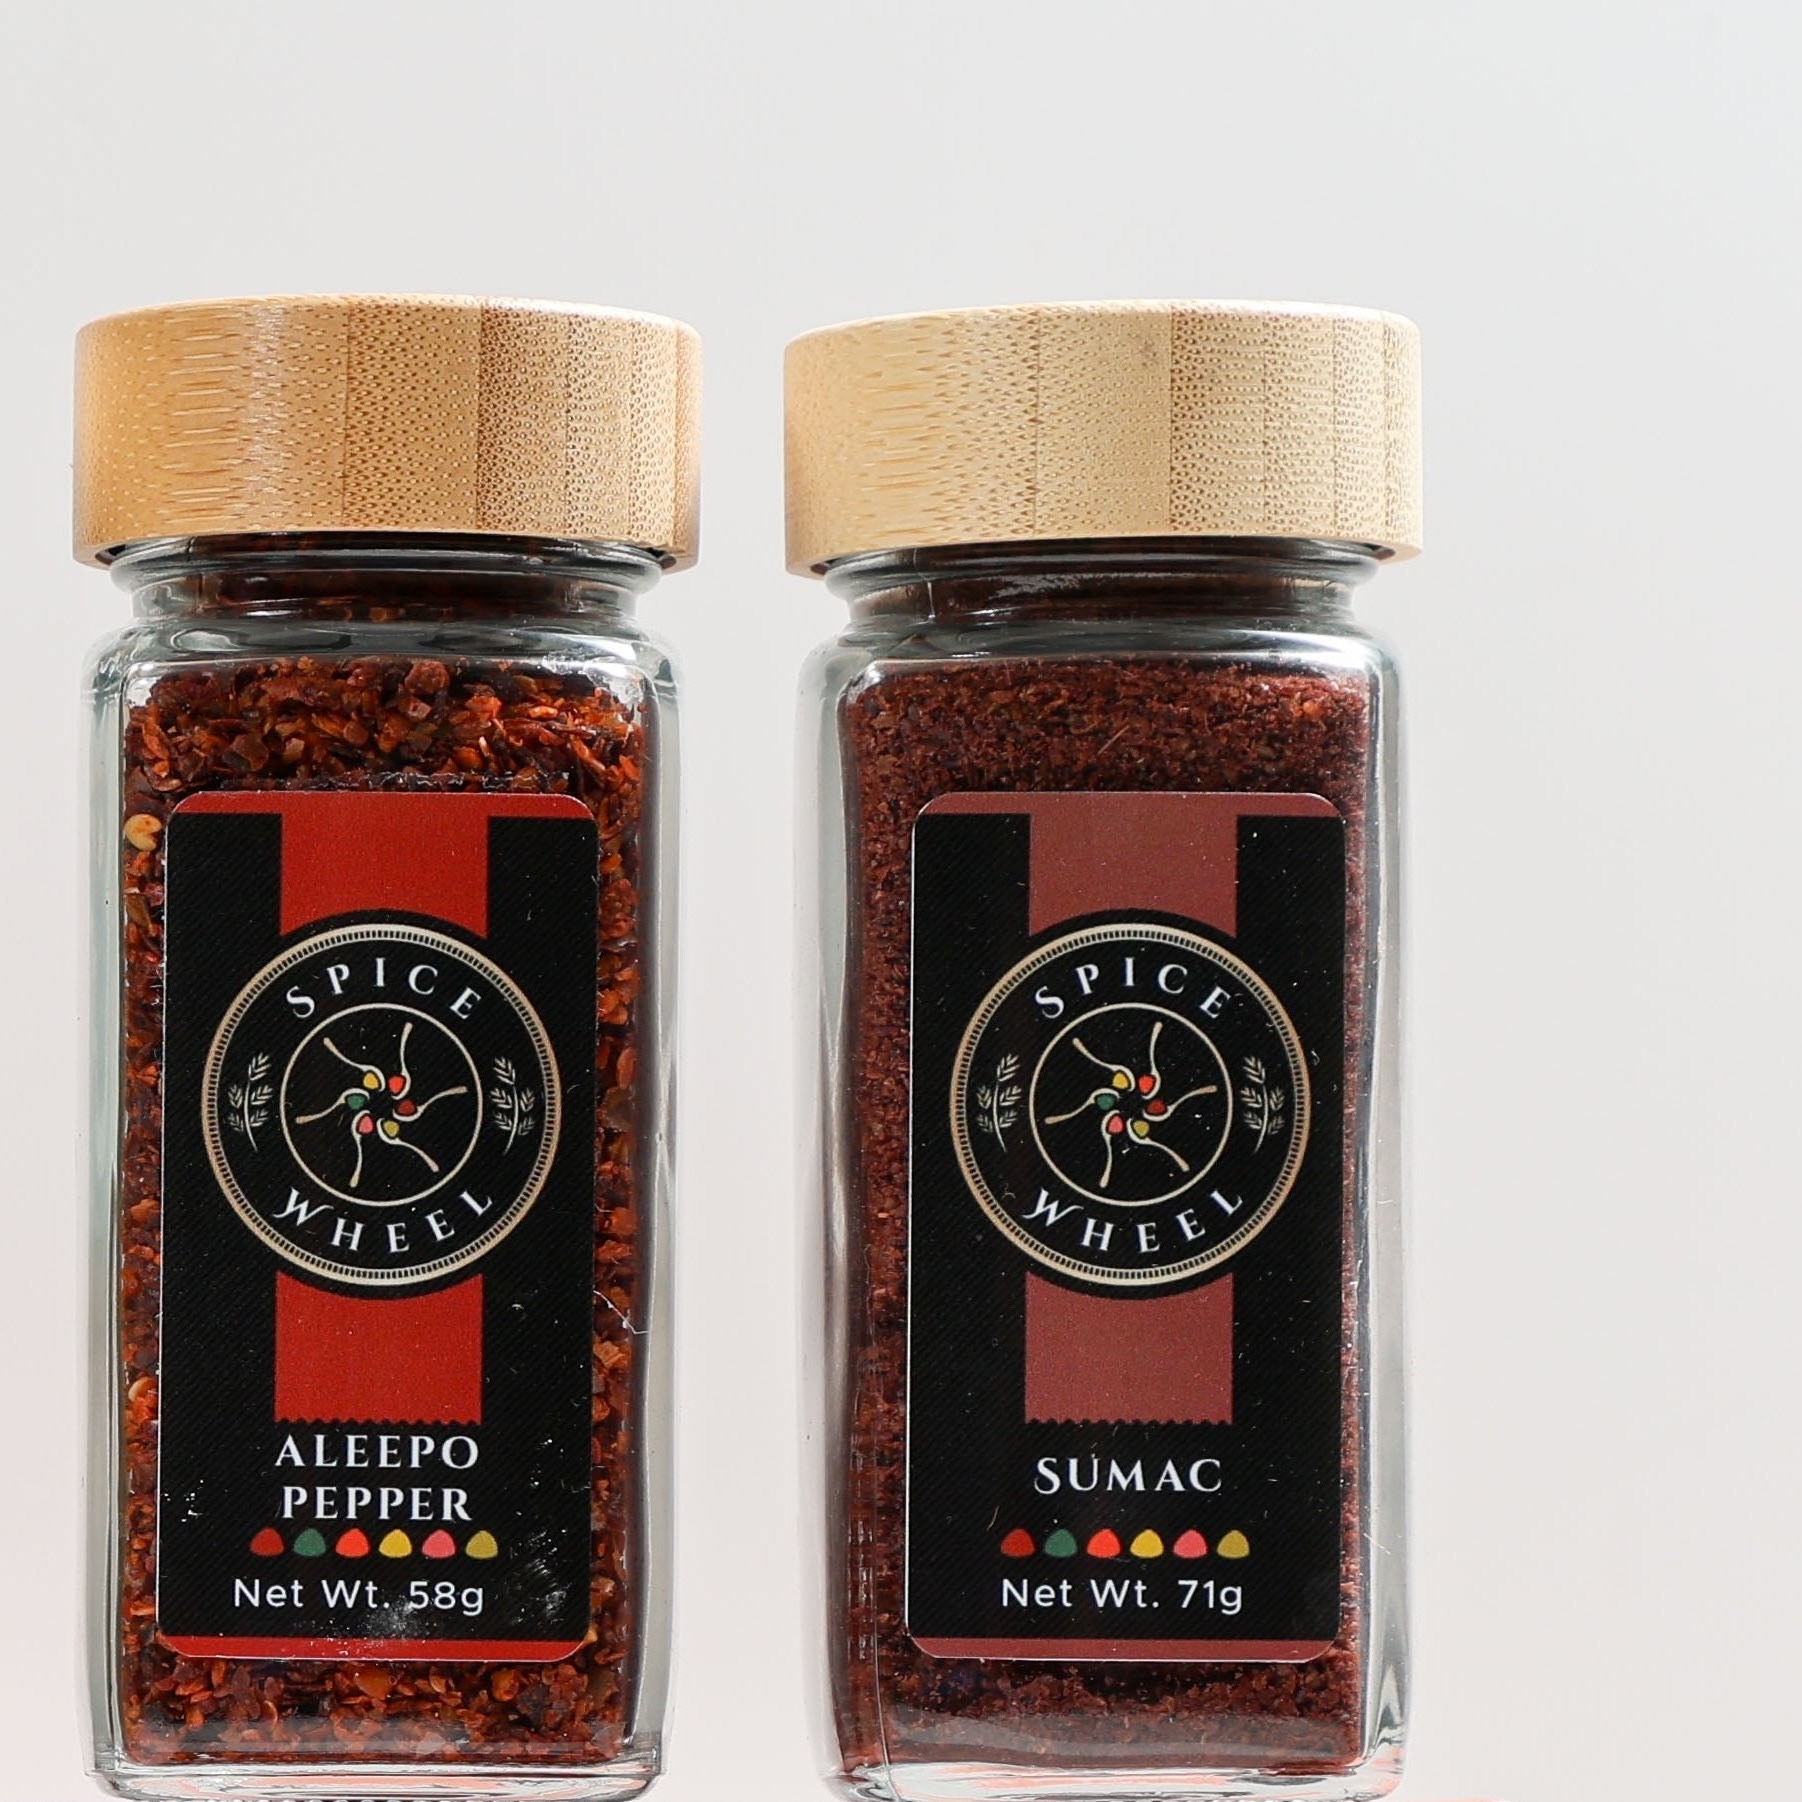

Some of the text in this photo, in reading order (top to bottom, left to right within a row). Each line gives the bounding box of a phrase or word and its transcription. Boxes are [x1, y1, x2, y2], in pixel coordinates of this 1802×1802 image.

[287, 957, 482, 1018] SPICE
[1035, 957, 1231, 1018] SPICE
[273, 1187, 492, 1254] WHEEL
[1023, 1188, 1242, 1254] WHEEL
[274, 1434, 479, 1469] ALEEPO
[1034, 1457, 1222, 1494] SUMAC
[282, 1486, 471, 1521] PEPPER
[234, 1579, 485, 1615] Net Wt. 58g
[1002, 1579, 1243, 1615] Net Wt. 71g
